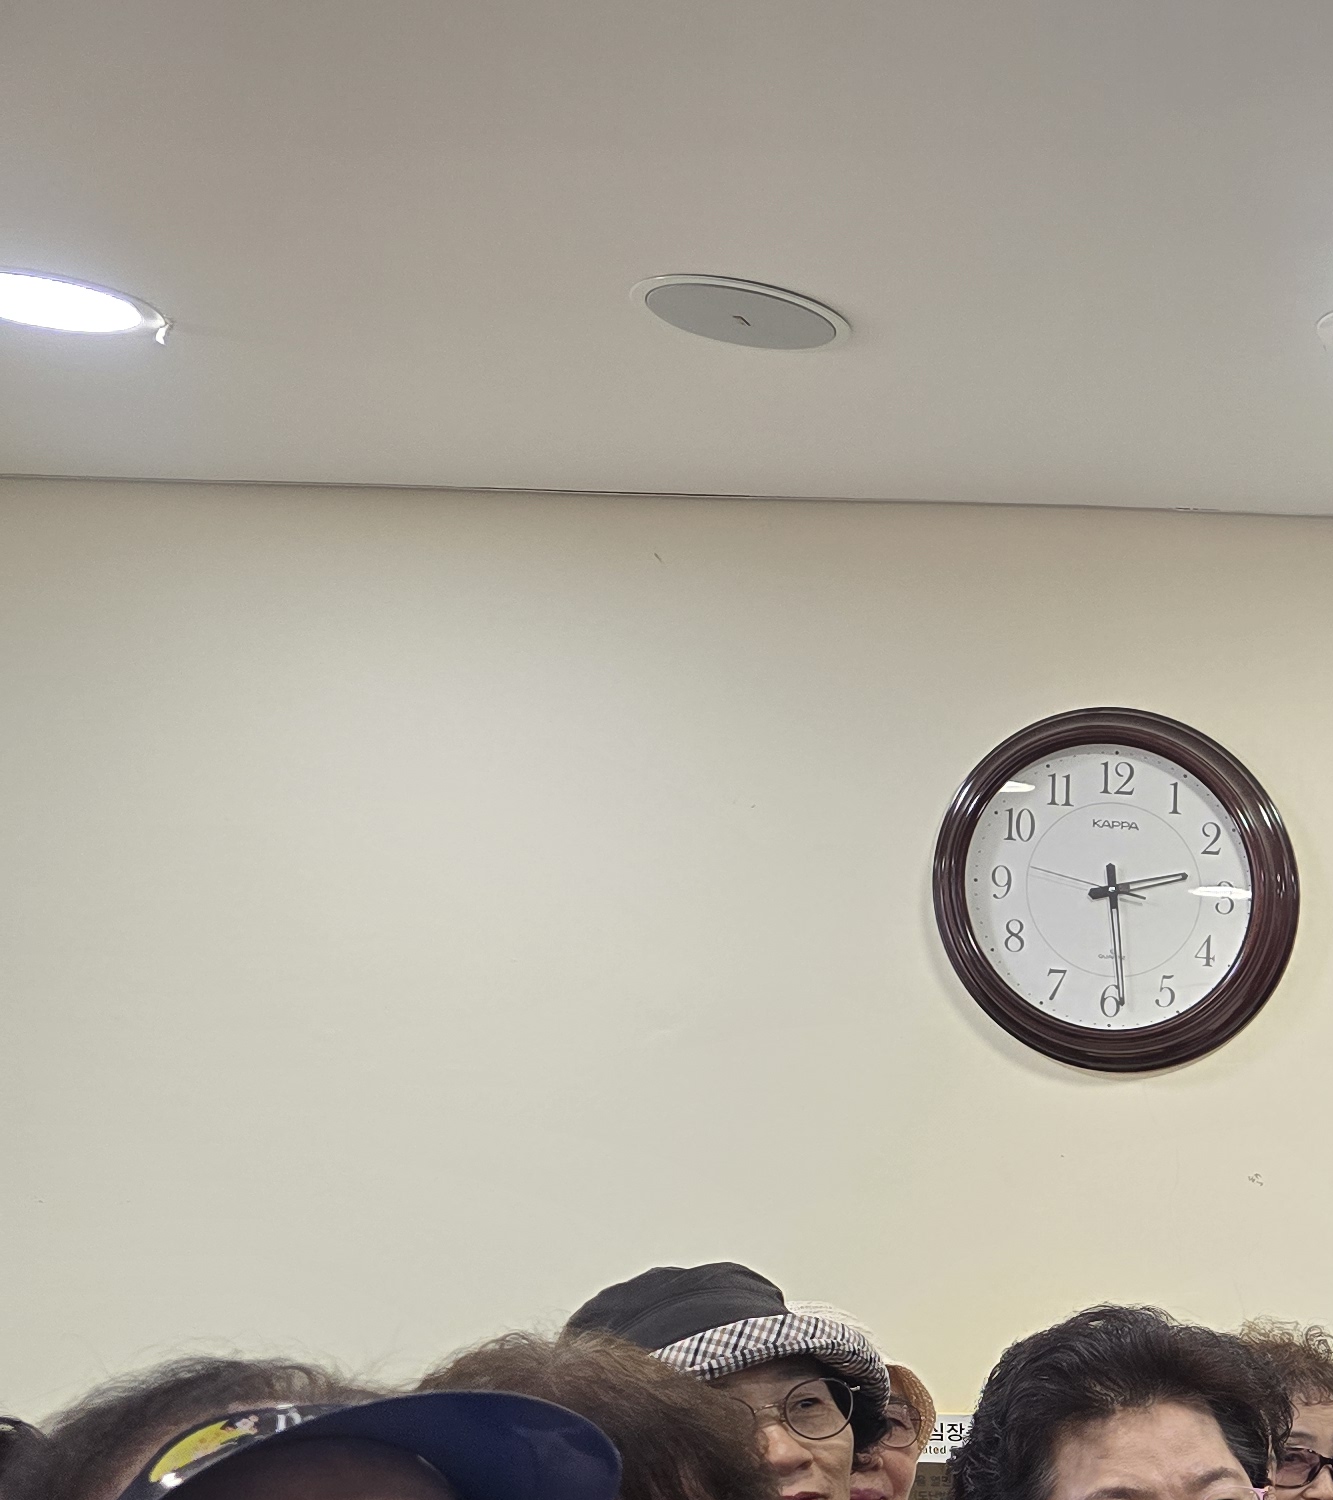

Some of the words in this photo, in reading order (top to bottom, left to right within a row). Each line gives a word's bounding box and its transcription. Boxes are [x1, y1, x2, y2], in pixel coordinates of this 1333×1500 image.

[1046, 773, 1074, 807] 11
[1100, 761, 1136, 796] 12
[1168, 782, 1182, 815] 1
[1003, 807, 1036, 842] 10
[1092, 819, 1139, 831] KAPPA
[1201, 822, 1222, 855] 2
[991, 865, 1012, 899] 9
[1214, 881, 1235, 915] 3
[1004, 919, 1025, 953] 8
[1194, 935, 1216, 967] 4
[1047, 968, 1067, 1001] 7
[1100, 984, 1122, 1018] 6
[1155, 975, 1176, 1008] 5
